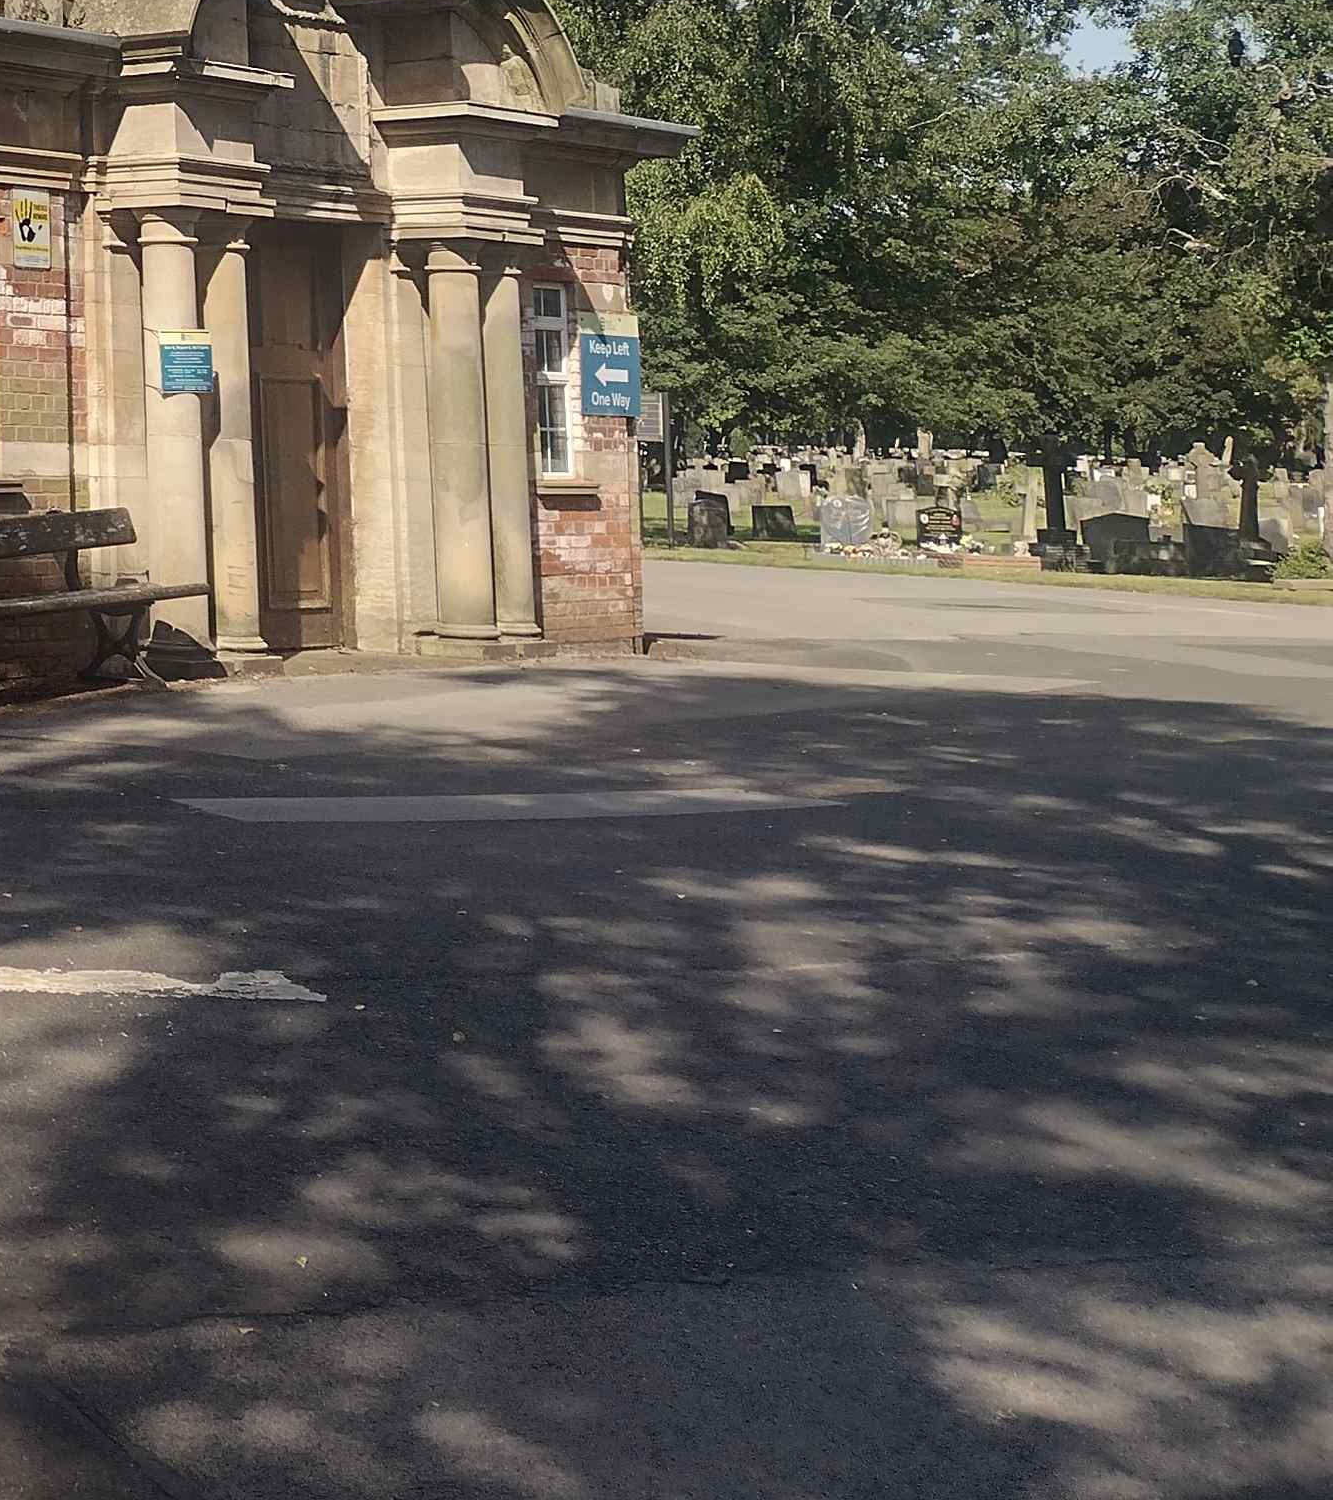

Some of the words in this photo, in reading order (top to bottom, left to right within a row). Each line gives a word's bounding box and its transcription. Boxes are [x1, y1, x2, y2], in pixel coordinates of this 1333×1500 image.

[589, 340, 612, 358] Keep
[613, 341, 630, 356] Left
[591, 391, 611, 406] One
[611, 392, 631, 411] Way
